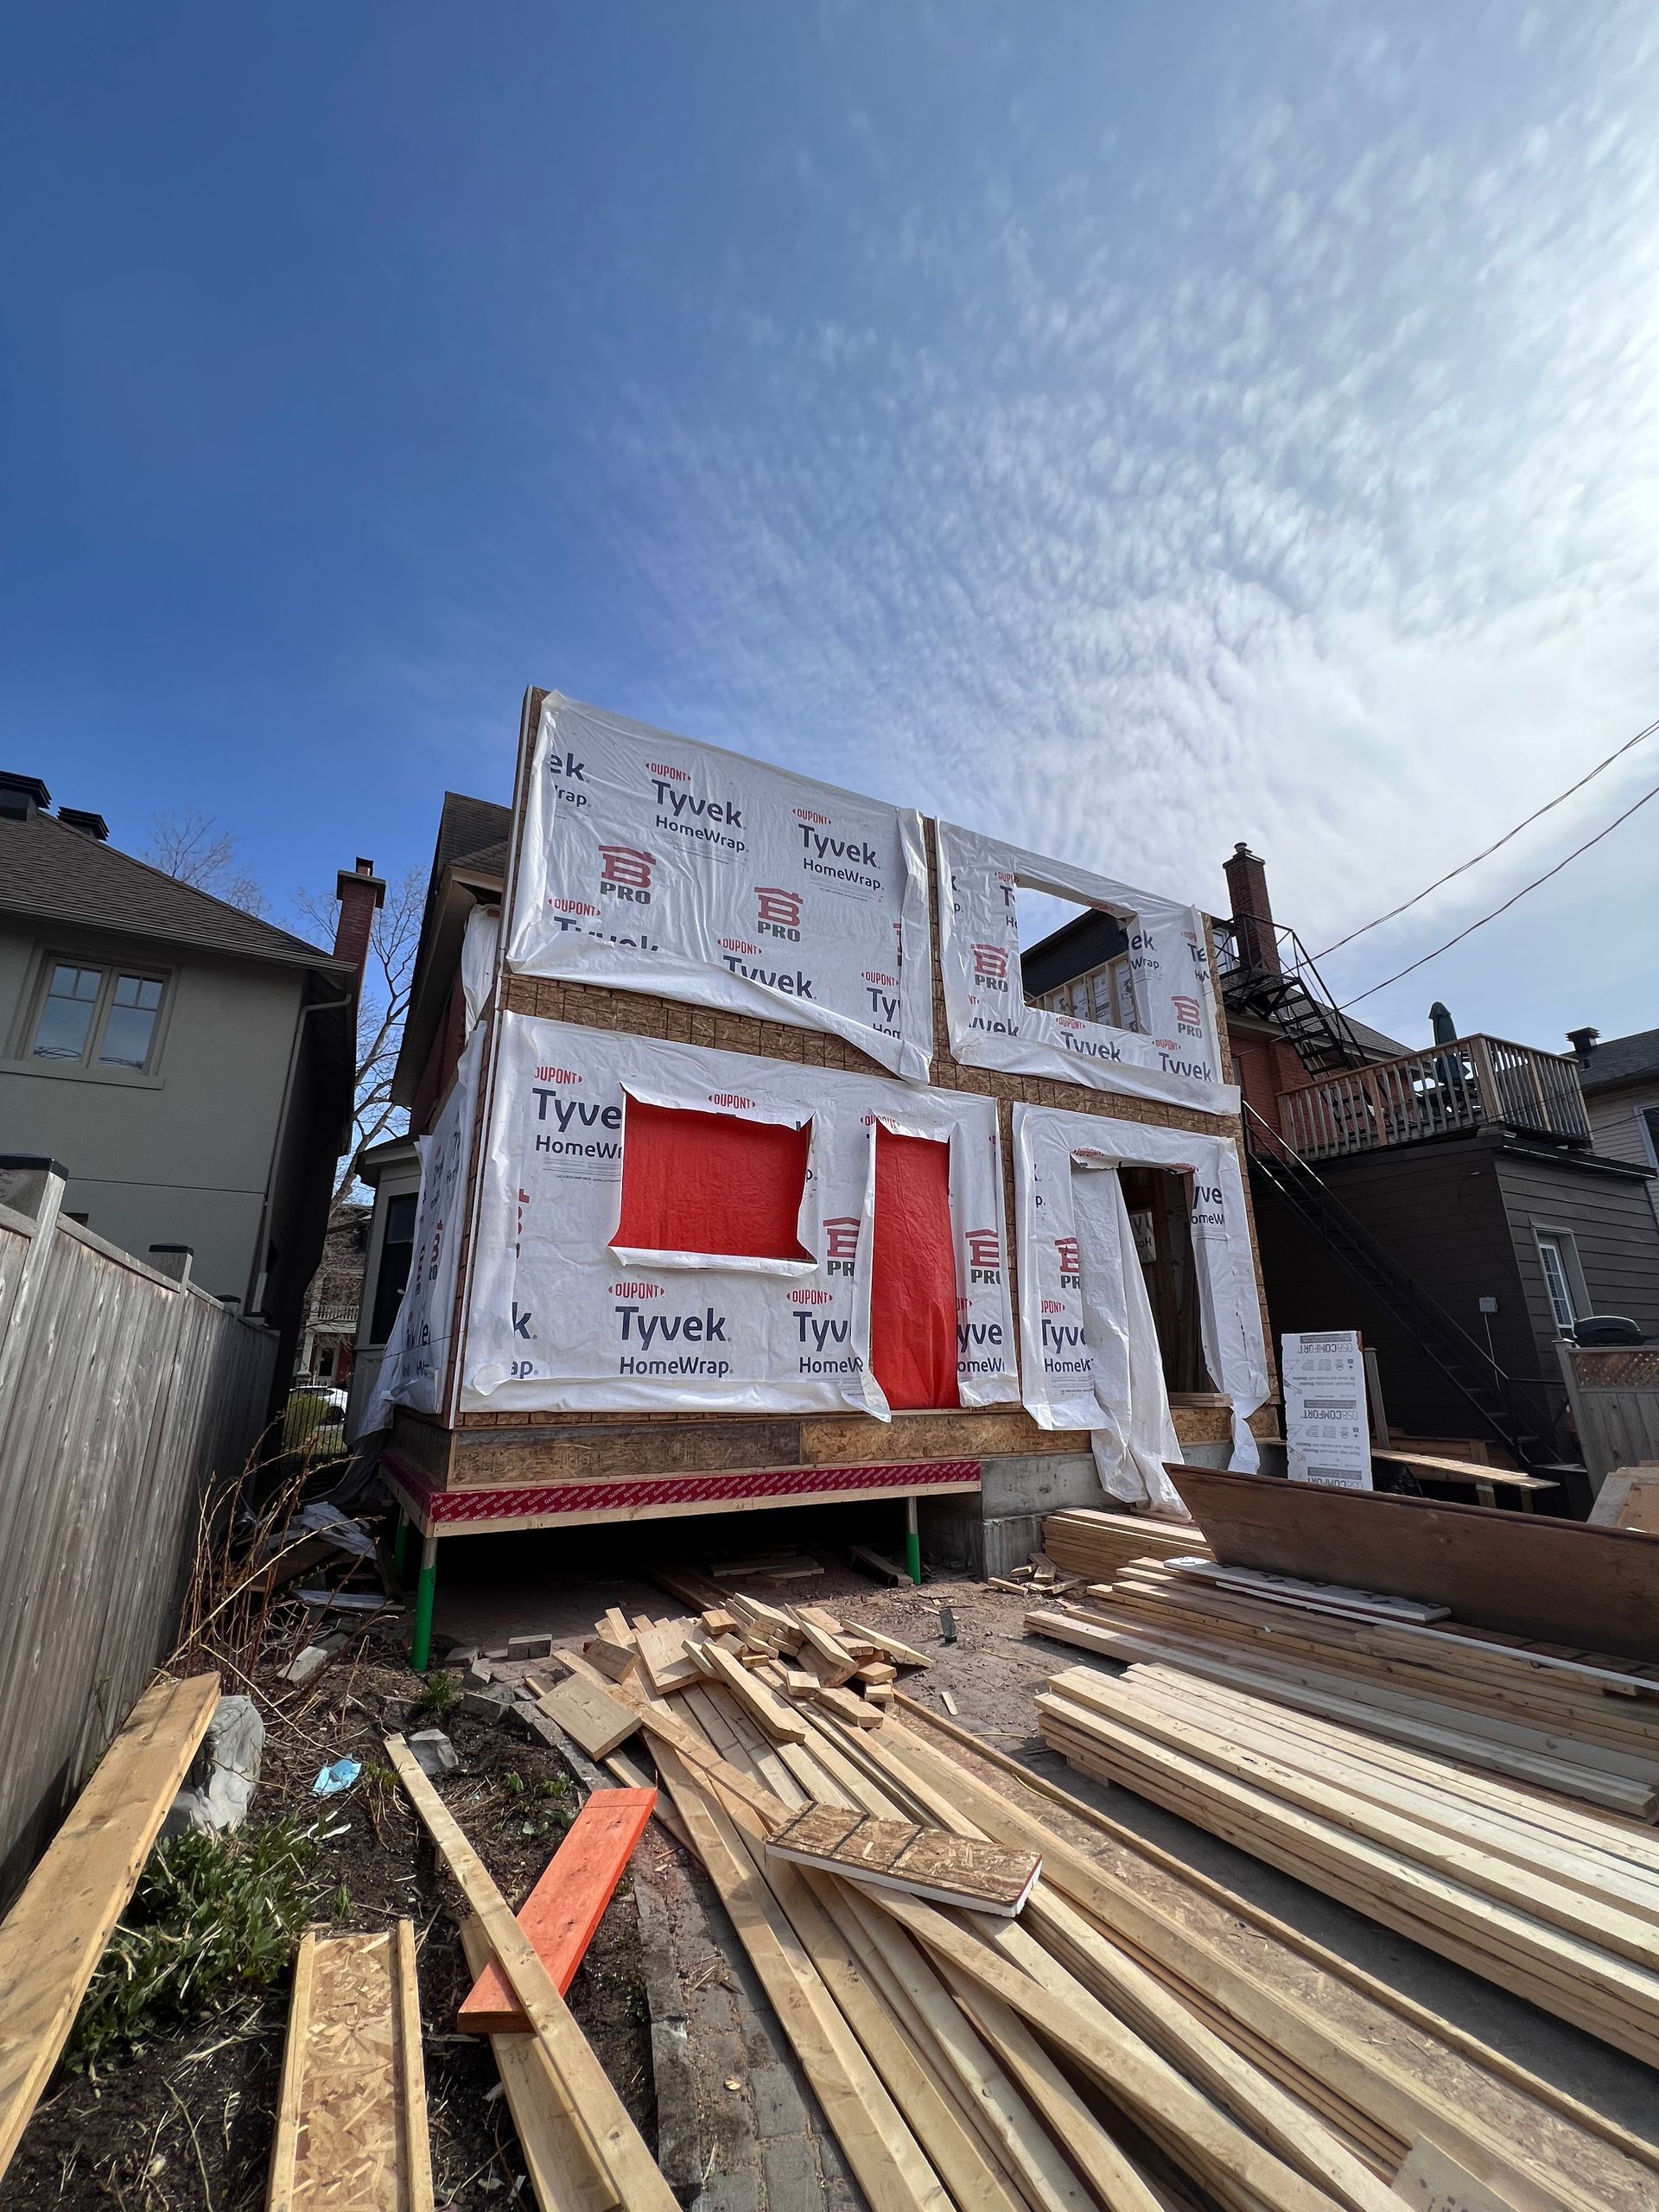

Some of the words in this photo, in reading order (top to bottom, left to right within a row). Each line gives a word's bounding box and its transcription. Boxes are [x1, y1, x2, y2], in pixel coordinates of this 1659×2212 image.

[652, 779, 742, 828] Tyvek
[656, 815, 746, 853] HomeWrap
[798, 823, 877, 868] Tyvek
[804, 858, 880, 890] HomeWrap
[601, 881, 651, 905] PRO
[758, 920, 800, 942] PRO
[975, 974, 1008, 992] PRO
[867, 987, 900, 1022] Ty
[1178, 1022, 1202, 1039] PRO
[615, 1282, 658, 1299] DUPONT
[792, 1290, 828, 1305] DUPONT
[615, 1306, 727, 1351] Tyvek
[620, 1356, 729, 1378] HomeWrap
